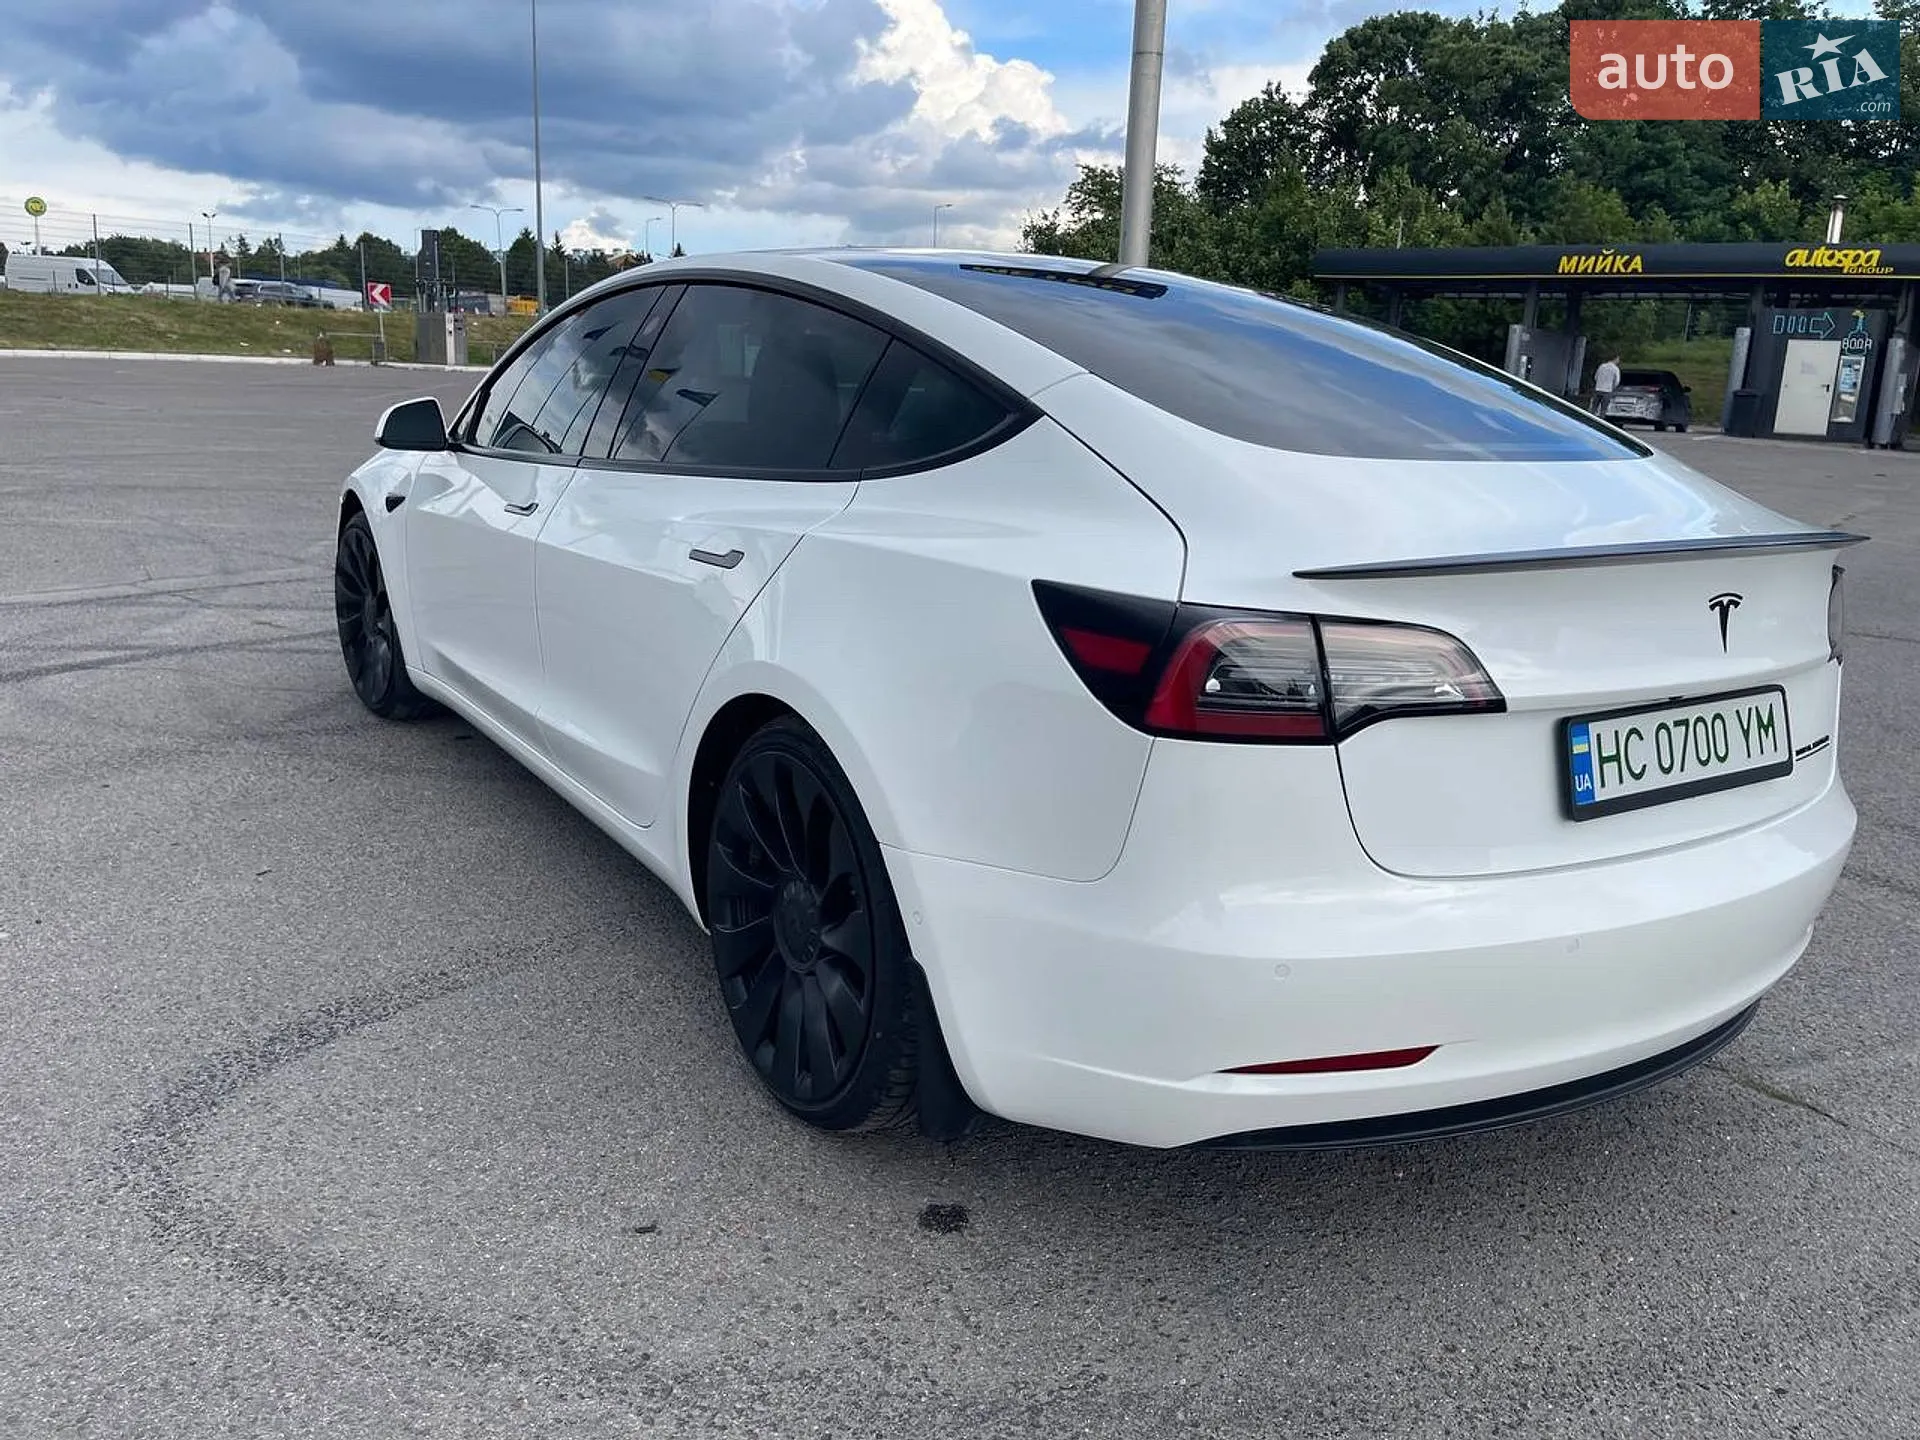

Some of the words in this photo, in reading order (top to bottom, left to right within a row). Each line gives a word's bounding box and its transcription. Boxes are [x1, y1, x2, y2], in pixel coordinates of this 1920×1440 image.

[1558, 248, 1643, 274] МИЙКА
[1784, 246, 1882, 274] autospa
[1848, 266, 1894, 275] GROUP
[1596, 727, 1647, 788] HC
[1654, 712, 1730, 776] 0700
[1735, 703, 1778, 759] YM
[1574, 773, 1593, 792] UA
